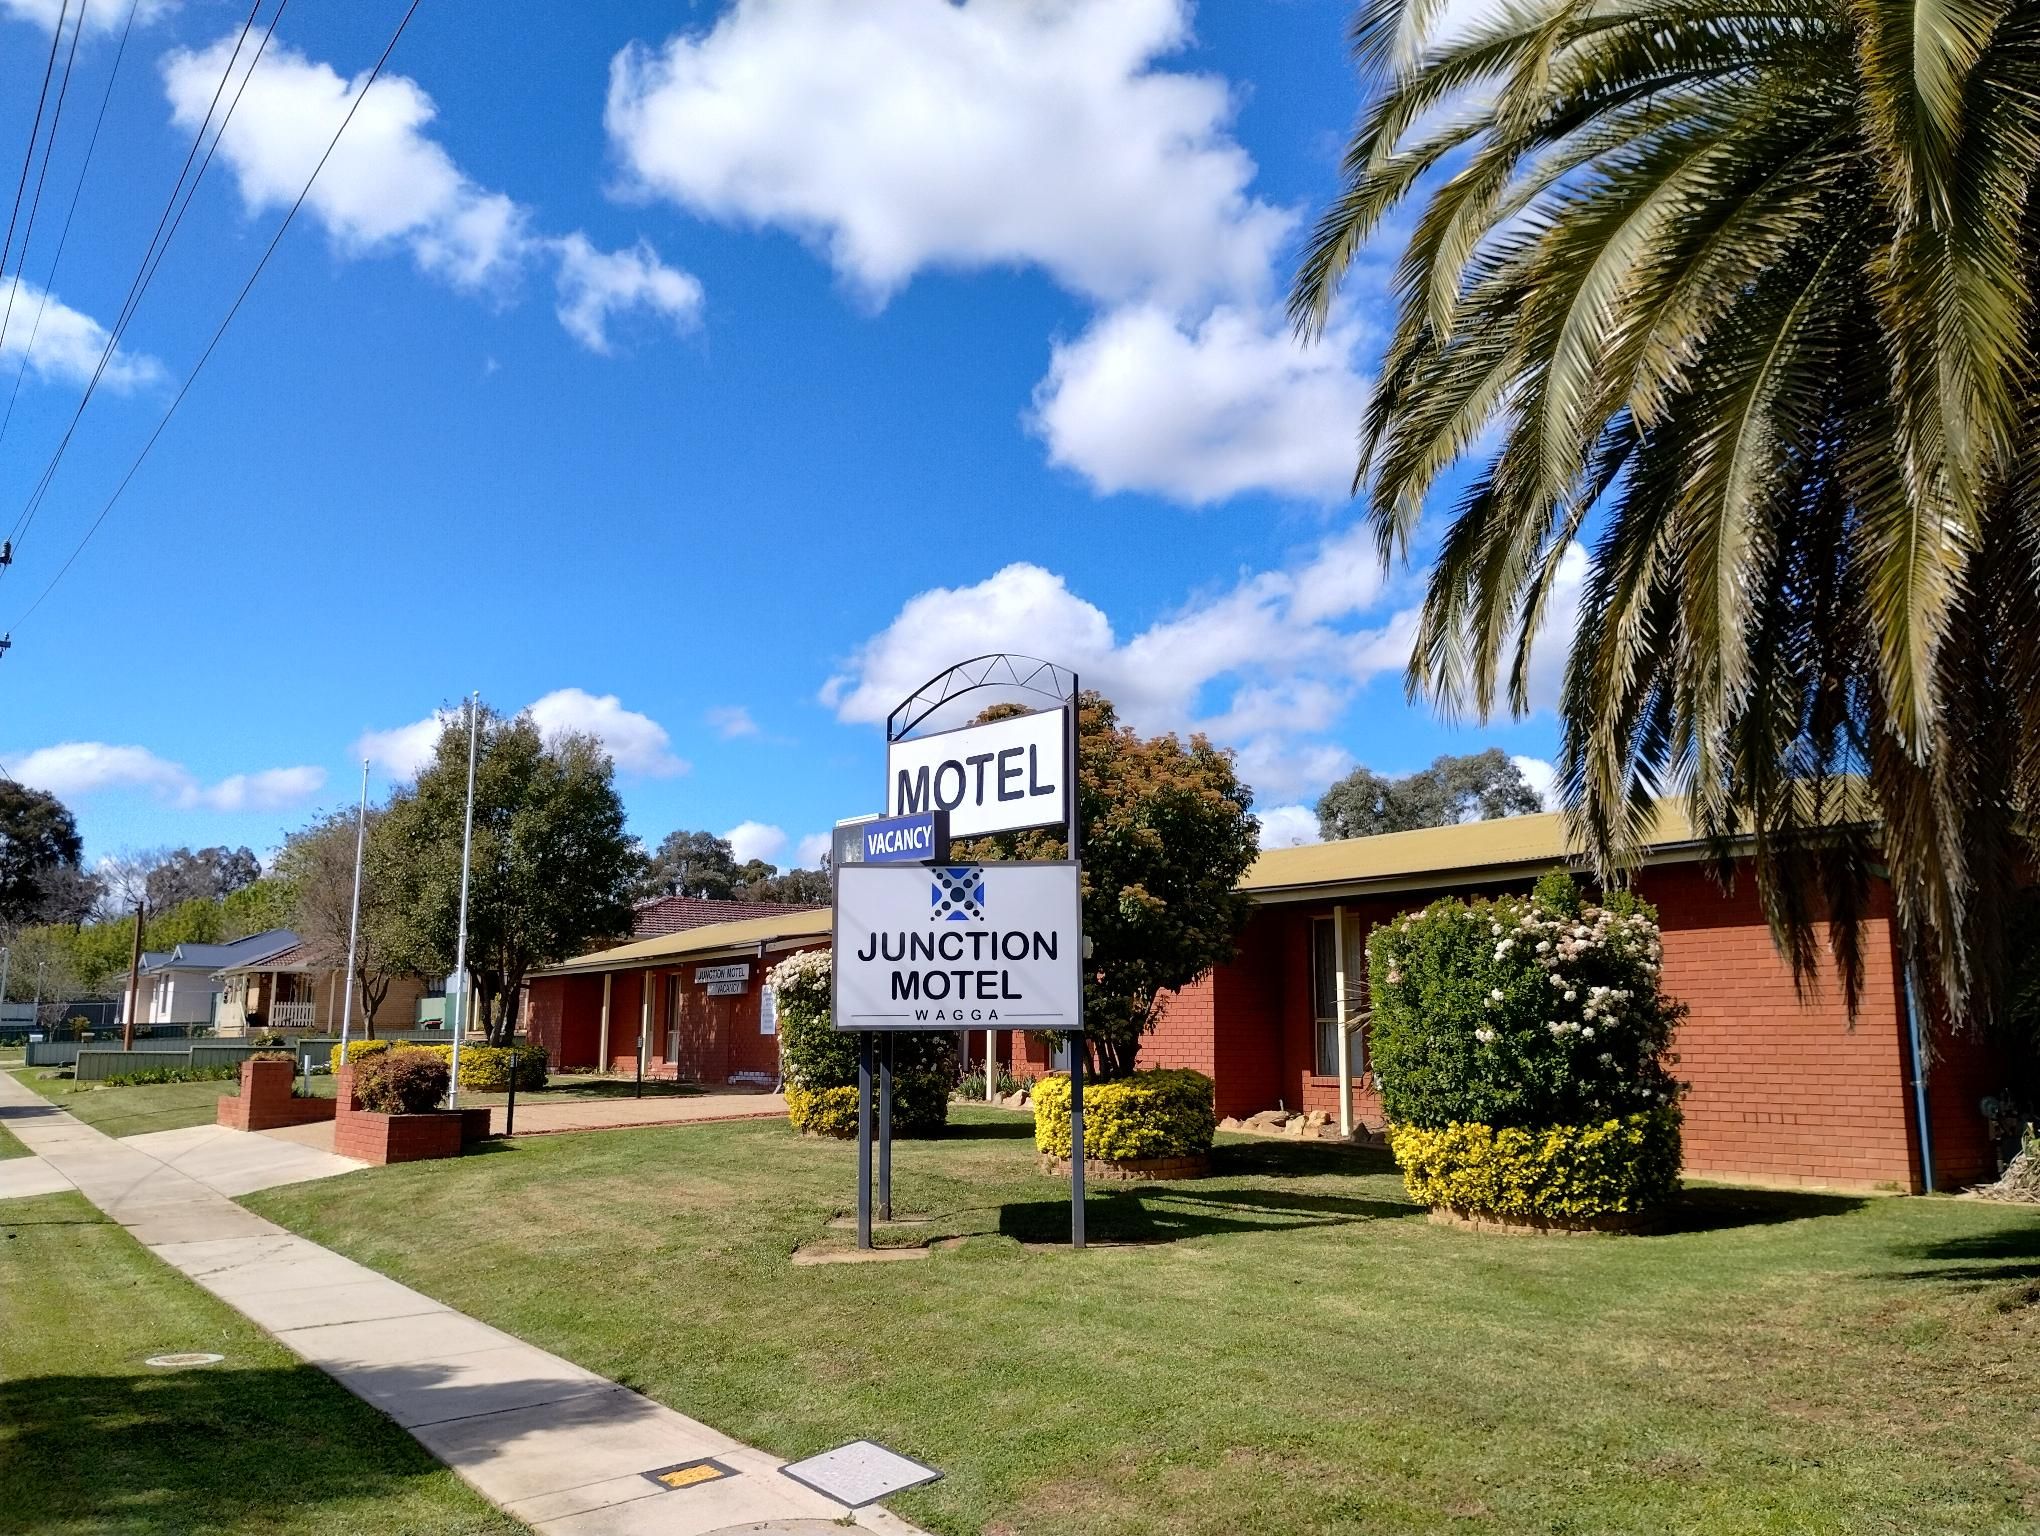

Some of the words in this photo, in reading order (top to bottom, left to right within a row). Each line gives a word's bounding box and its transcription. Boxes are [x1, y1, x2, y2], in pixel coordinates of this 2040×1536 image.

[897, 743, 1055, 816] MOTEL
[868, 824, 932, 856] VACANCY
[857, 930, 1058, 962] JUNCTION
[698, 969, 725, 980] JUNCTION
[727, 968, 745, 978] MOTEL
[718, 984, 739, 994] VACANCY
[891, 970, 1022, 1000] MOTEL
[915, 1009, 999, 1021] WAGGA
